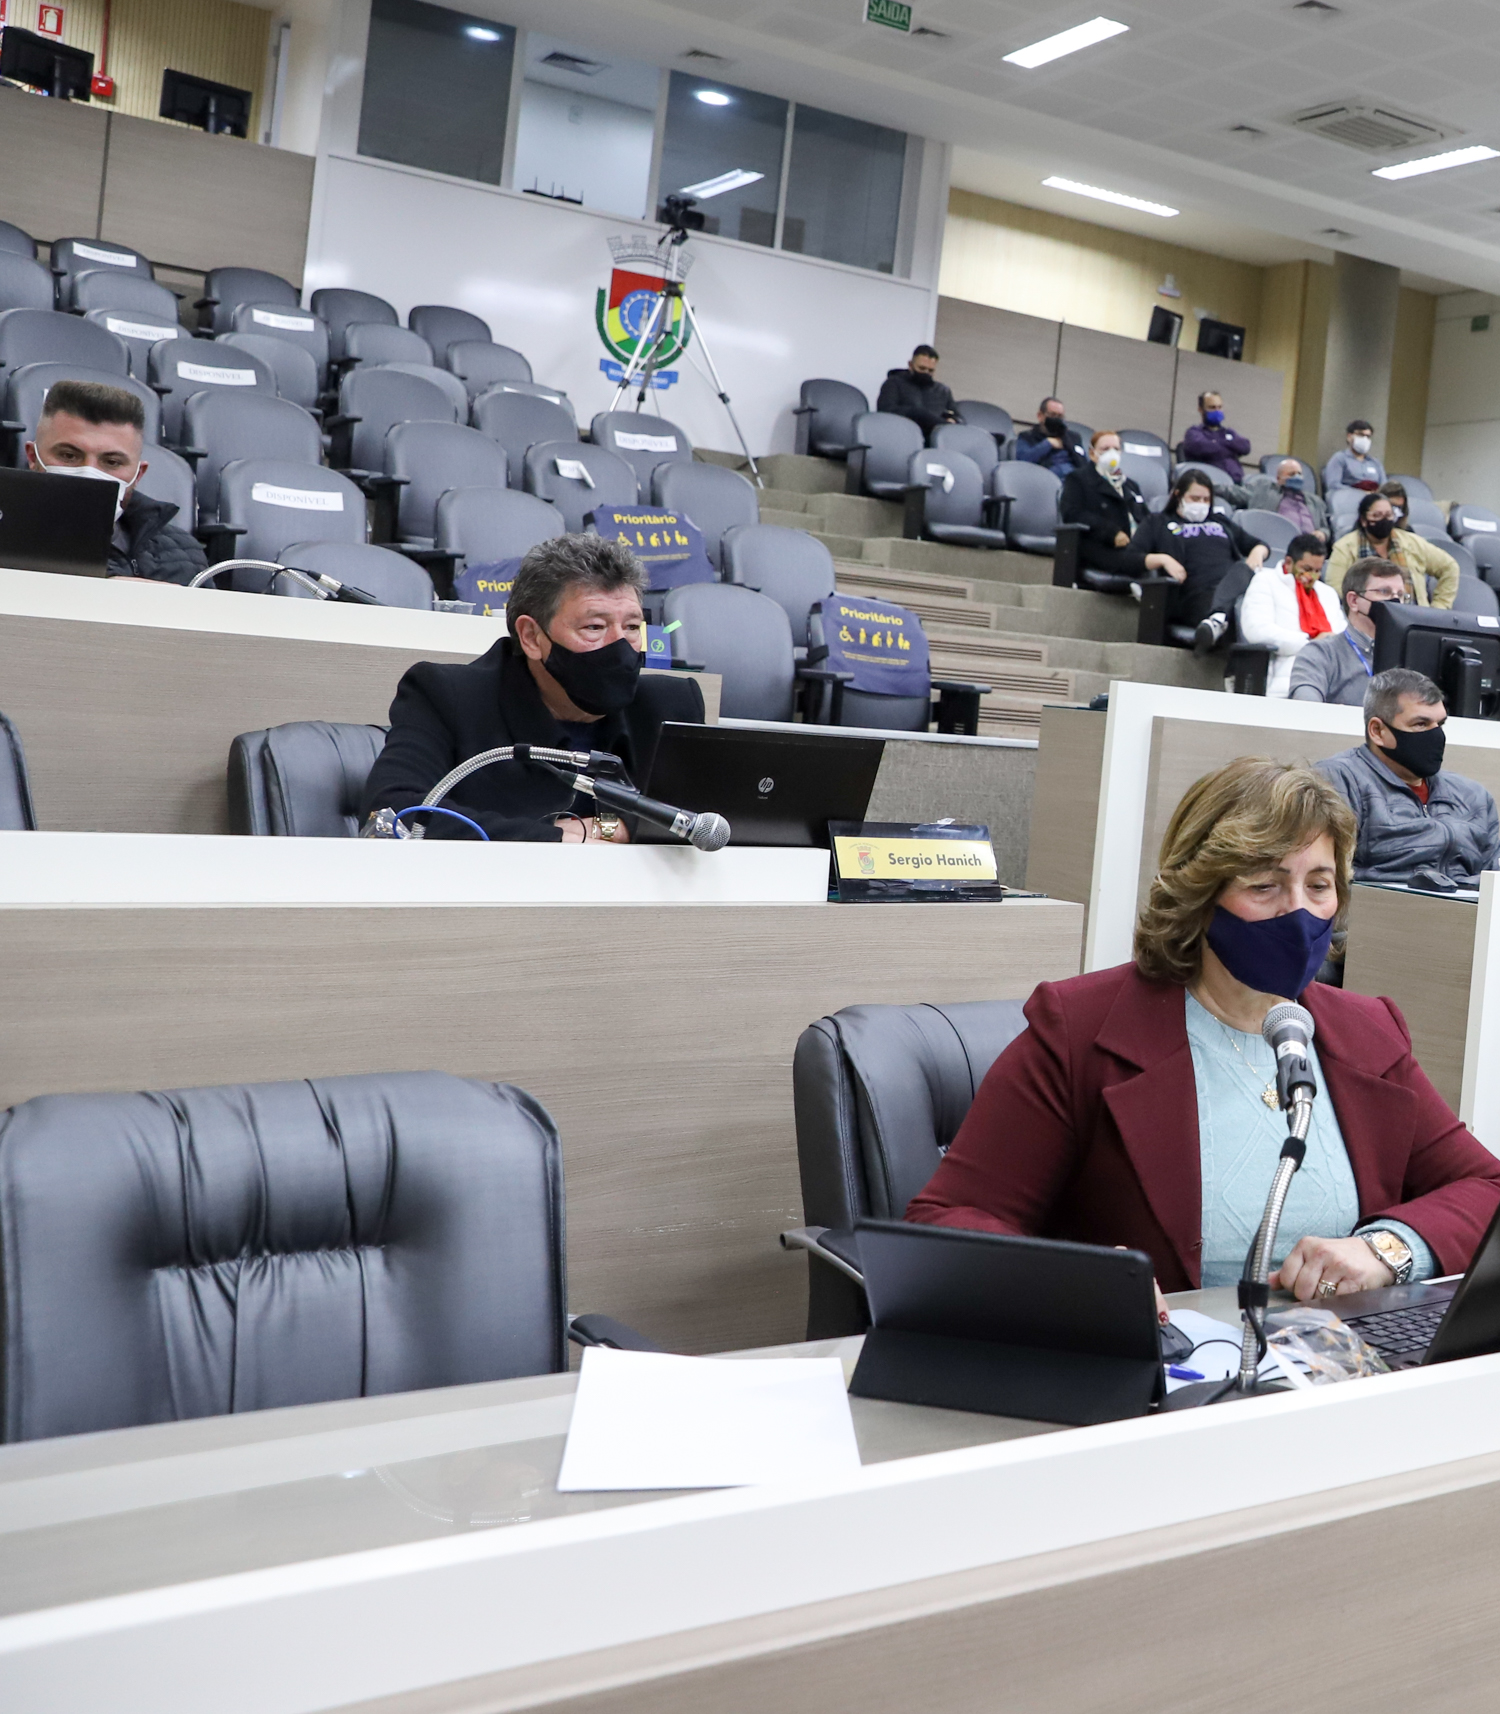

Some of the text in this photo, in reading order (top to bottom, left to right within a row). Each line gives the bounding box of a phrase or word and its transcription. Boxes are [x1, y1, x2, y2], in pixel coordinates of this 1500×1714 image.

[266, 490, 330, 506] DISPONÍVEL
[613, 513, 677, 525] Prioritário
[840, 606, 904, 626] Prioritário
[758, 777, 774, 793] hp
[888, 853, 982, 869] Sergio Hanich
